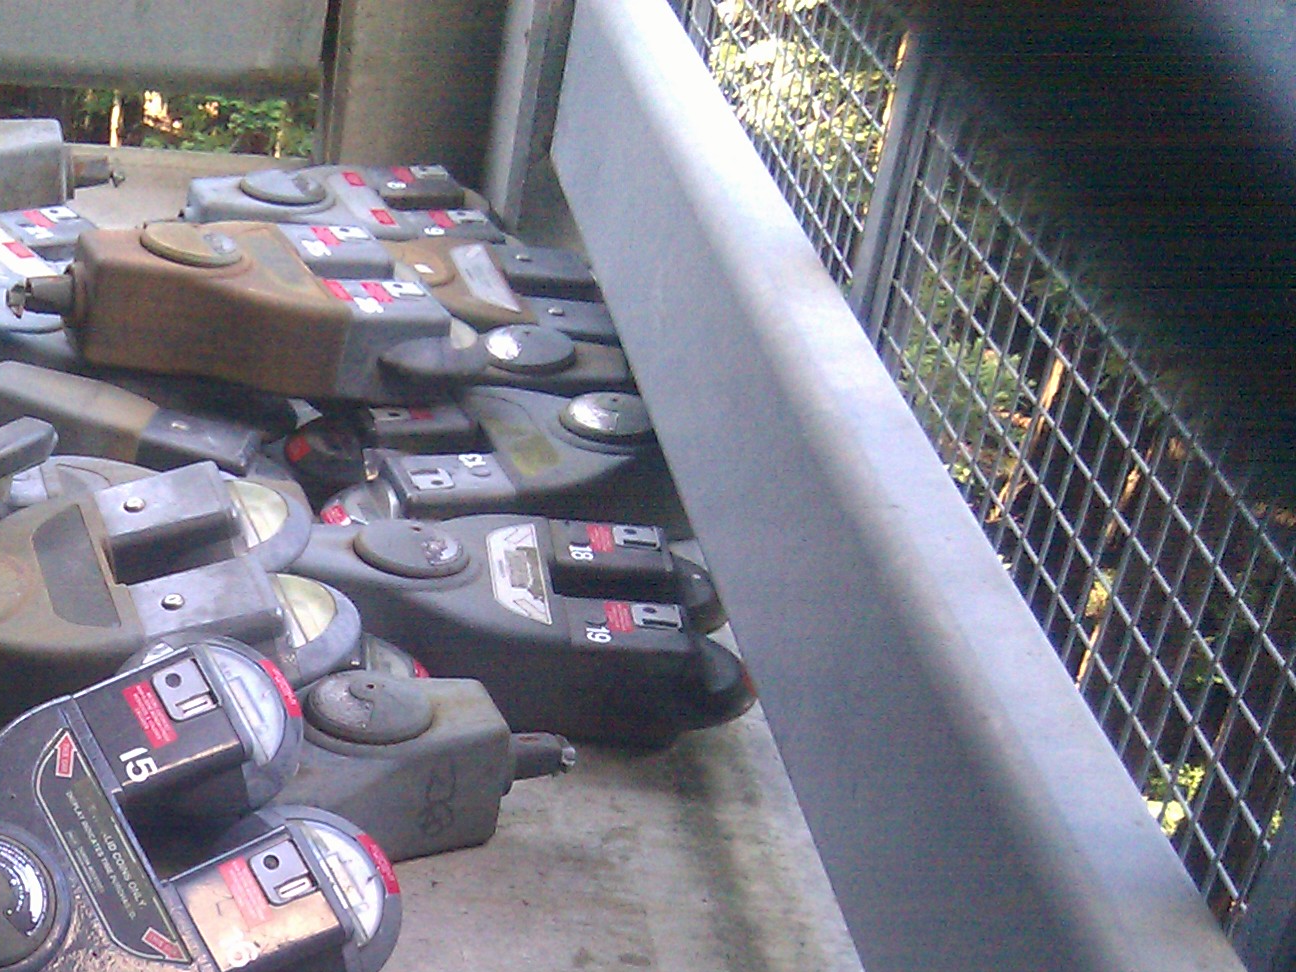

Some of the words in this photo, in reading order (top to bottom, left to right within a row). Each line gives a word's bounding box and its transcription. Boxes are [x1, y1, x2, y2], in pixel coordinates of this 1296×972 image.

[569, 544, 594, 562] 18
[586, 626, 612, 644] 19
[120, 747, 157, 783] 15
[111, 851, 133, 882] COINS
